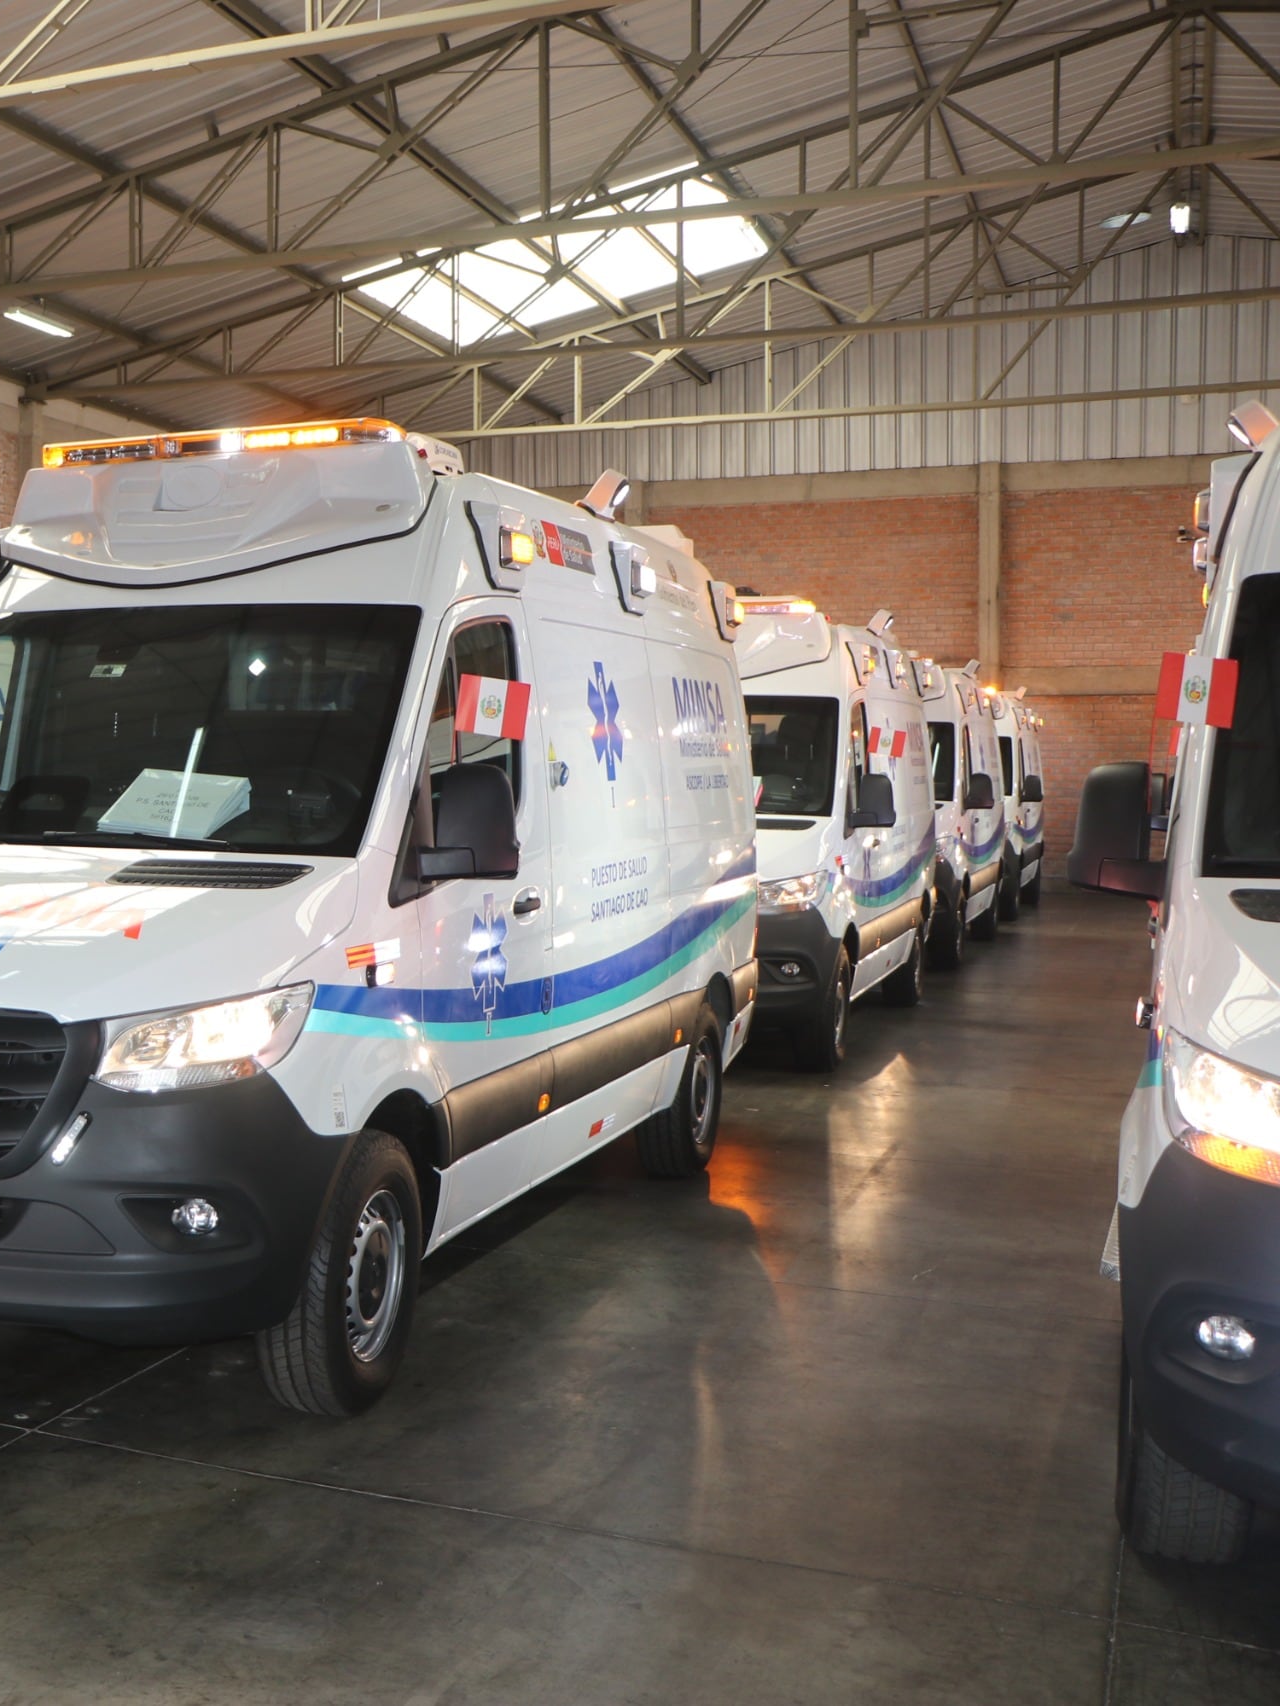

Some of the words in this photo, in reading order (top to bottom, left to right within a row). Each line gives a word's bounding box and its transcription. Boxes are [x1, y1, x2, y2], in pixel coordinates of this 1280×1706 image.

[671, 676, 727, 735] MINSA
[591, 862, 618, 889] PUESTO
[619, 860, 627, 881] DE
[628, 855, 648, 878] SALUD
[591, 893, 626, 923] SANTIAGO
[627, 890, 635, 912] DE
[636, 887, 649, 909] CAO
